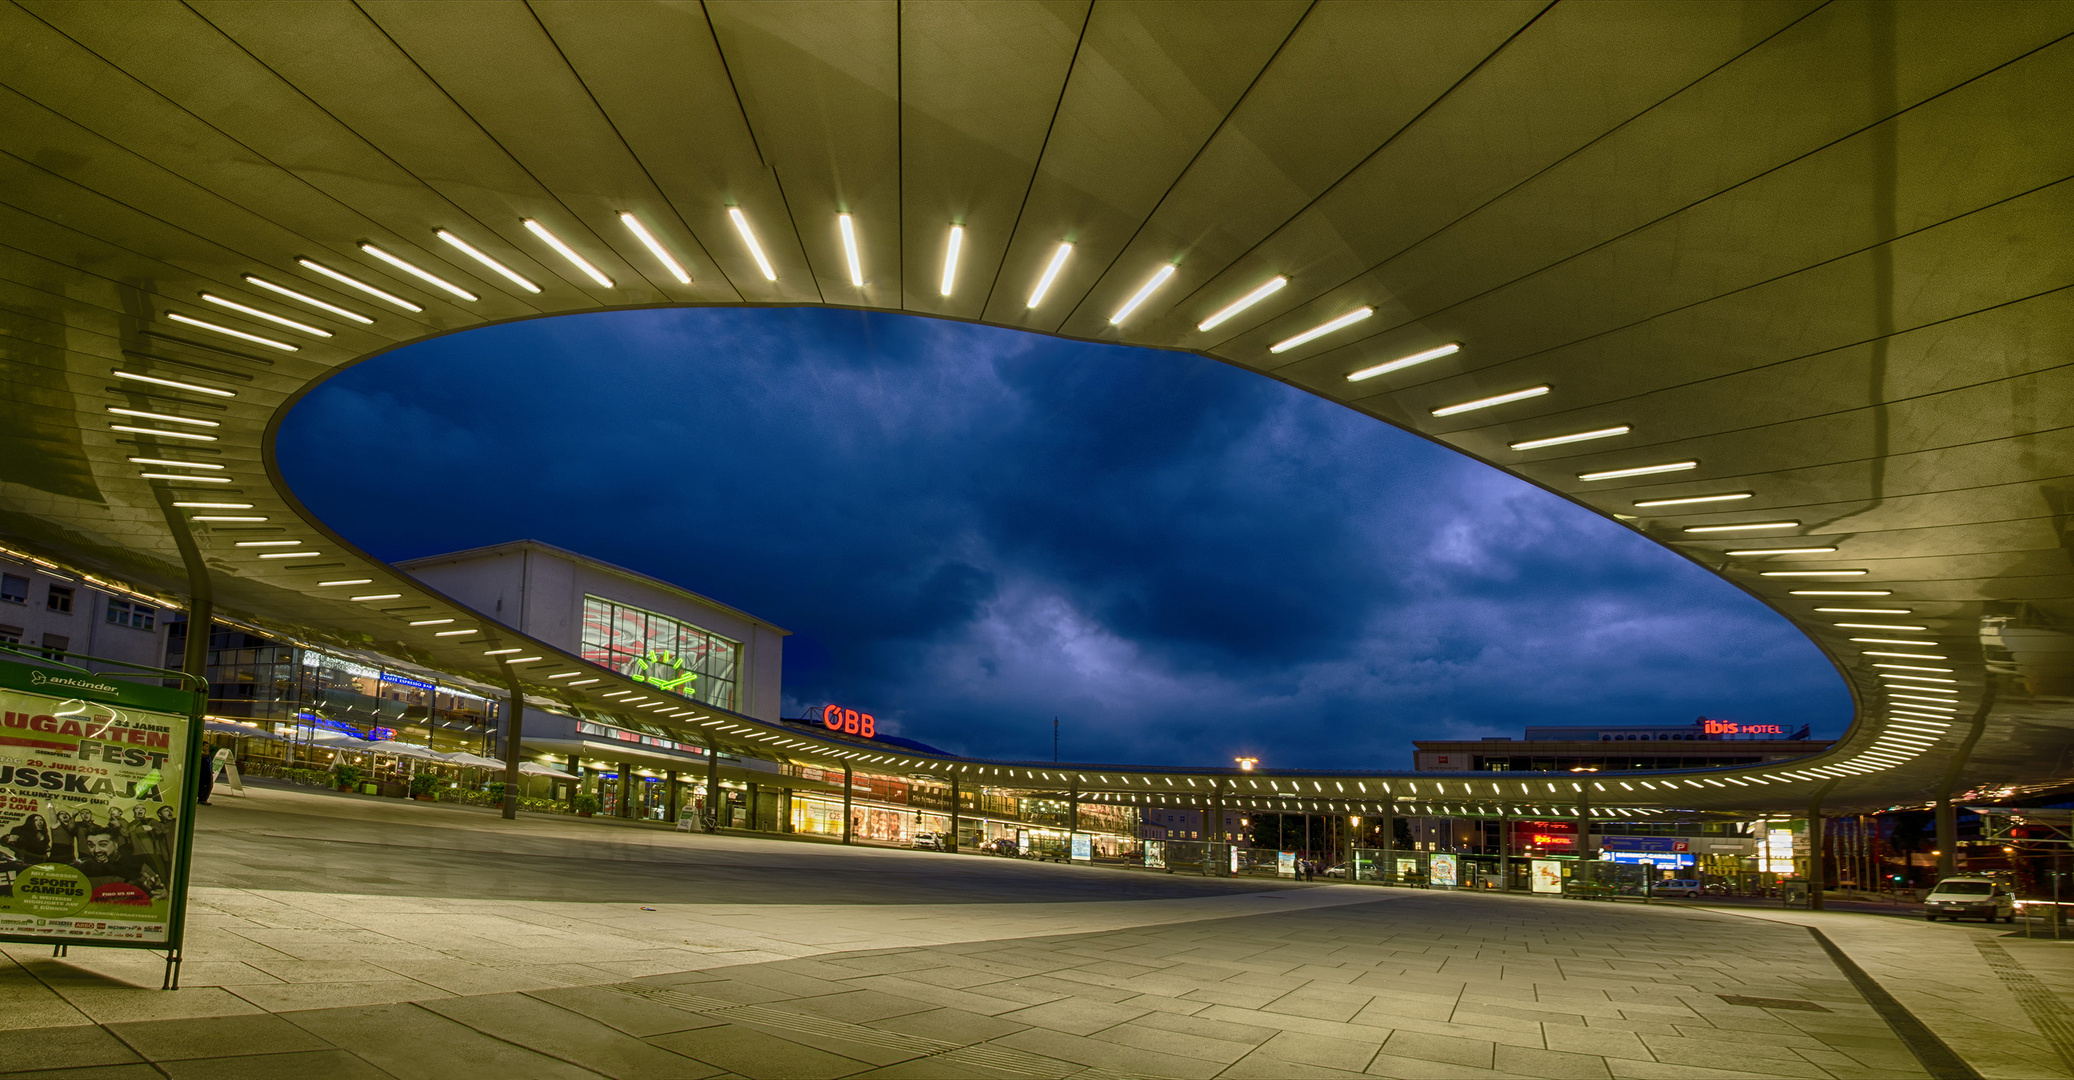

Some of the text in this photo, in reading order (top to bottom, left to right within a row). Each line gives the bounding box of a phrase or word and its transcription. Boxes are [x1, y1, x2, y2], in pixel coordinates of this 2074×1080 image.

[50, 675, 118, 692] ankünder
[399, 679, 422, 687] ESPRESSO
[115, 719, 170, 733] 33 JAHRE
[823, 704, 875, 738] ÖBB
[1704, 720, 1783, 734] ibis HOTEL
[0, 711, 170, 749] UGARTEN
[79, 739, 169, 769] FEST
[27, 758, 47, 768] 29.
[48, 762, 76, 772] JUNI
[78, 766, 108, 776] 2013
[10, 796, 27, 804] ON
[19, 789, 59, 800] KLUMZY
[62, 794, 88, 803] TUNG
[90, 798, 109, 806] (UK)
[9, 803, 38, 812] LOVE
[1702, 865, 1741, 877] ROT
[30, 877, 78, 888] SPORT
[20, 885, 84, 896] CAMPUS
